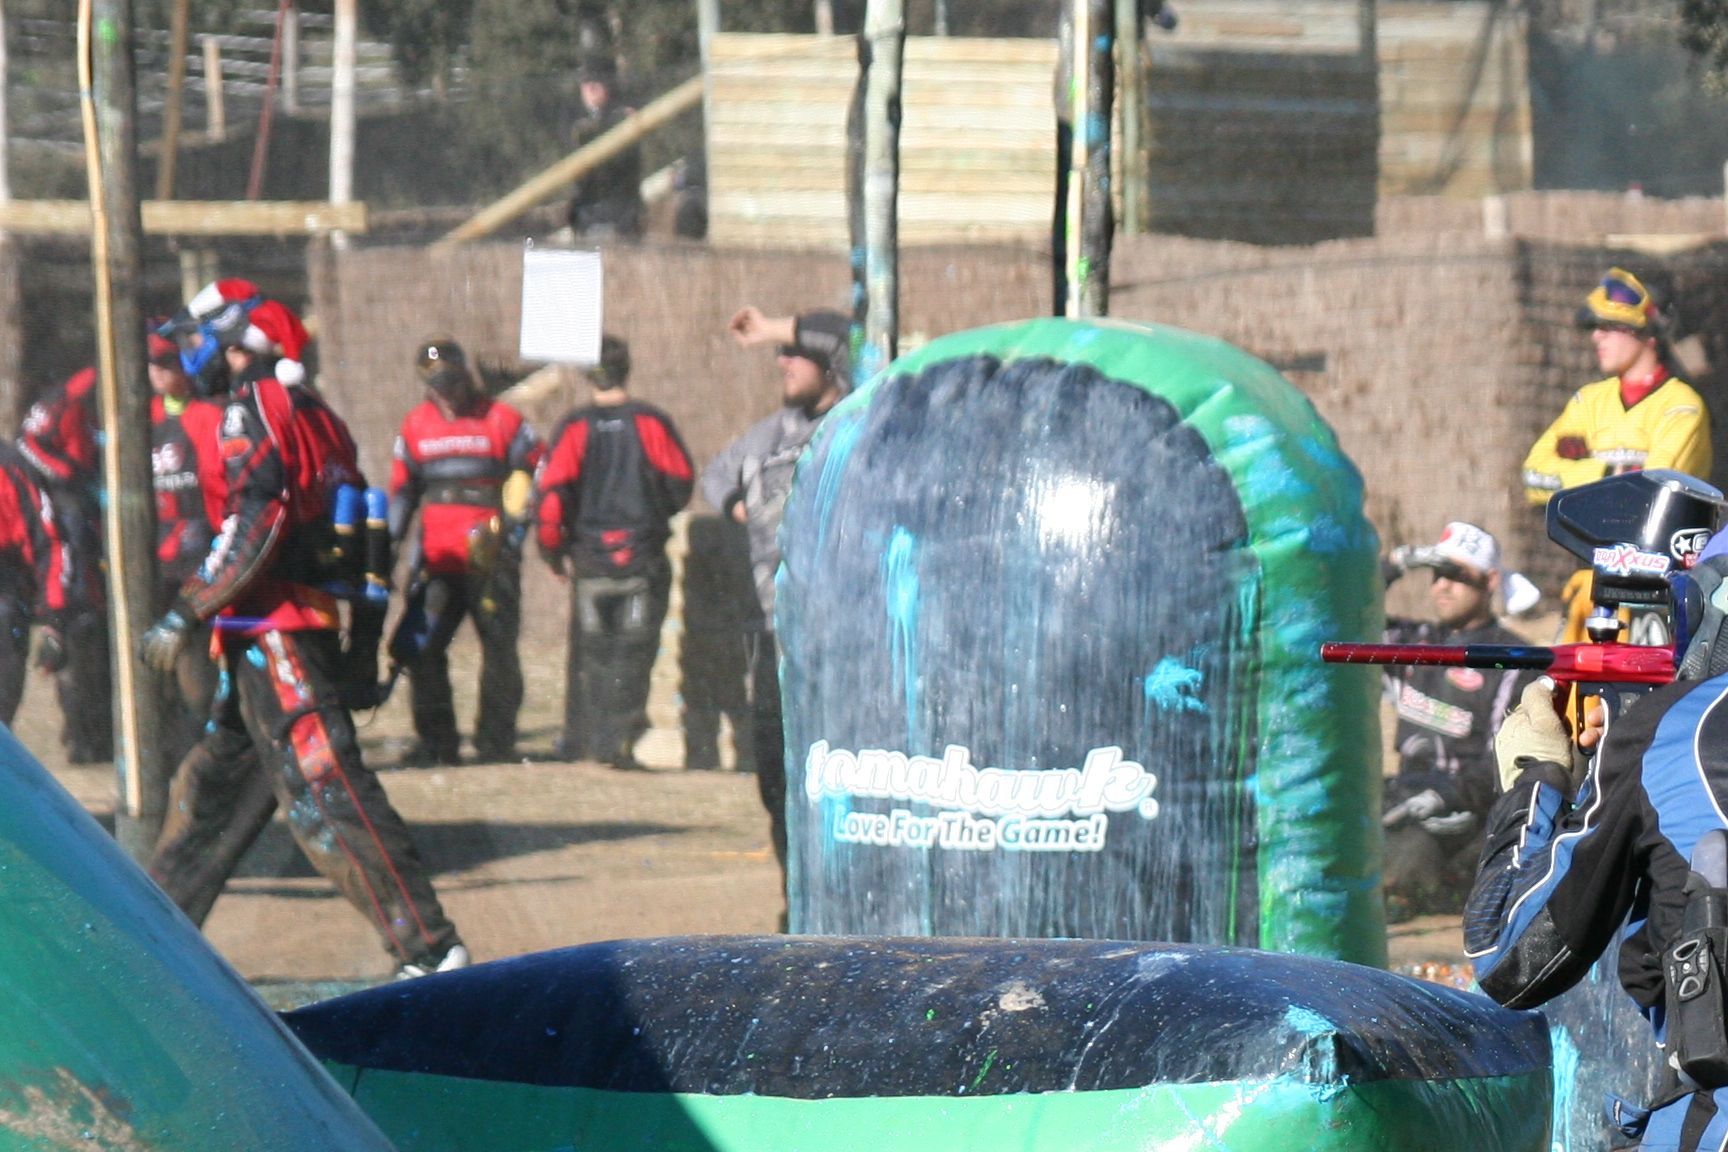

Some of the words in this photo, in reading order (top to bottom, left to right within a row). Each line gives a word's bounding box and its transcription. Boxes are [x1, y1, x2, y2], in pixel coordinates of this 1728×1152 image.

[836, 811, 886, 842] Love
[891, 812, 934, 844] For
[939, 814, 995, 847] The
[1000, 816, 1105, 848] Game!
